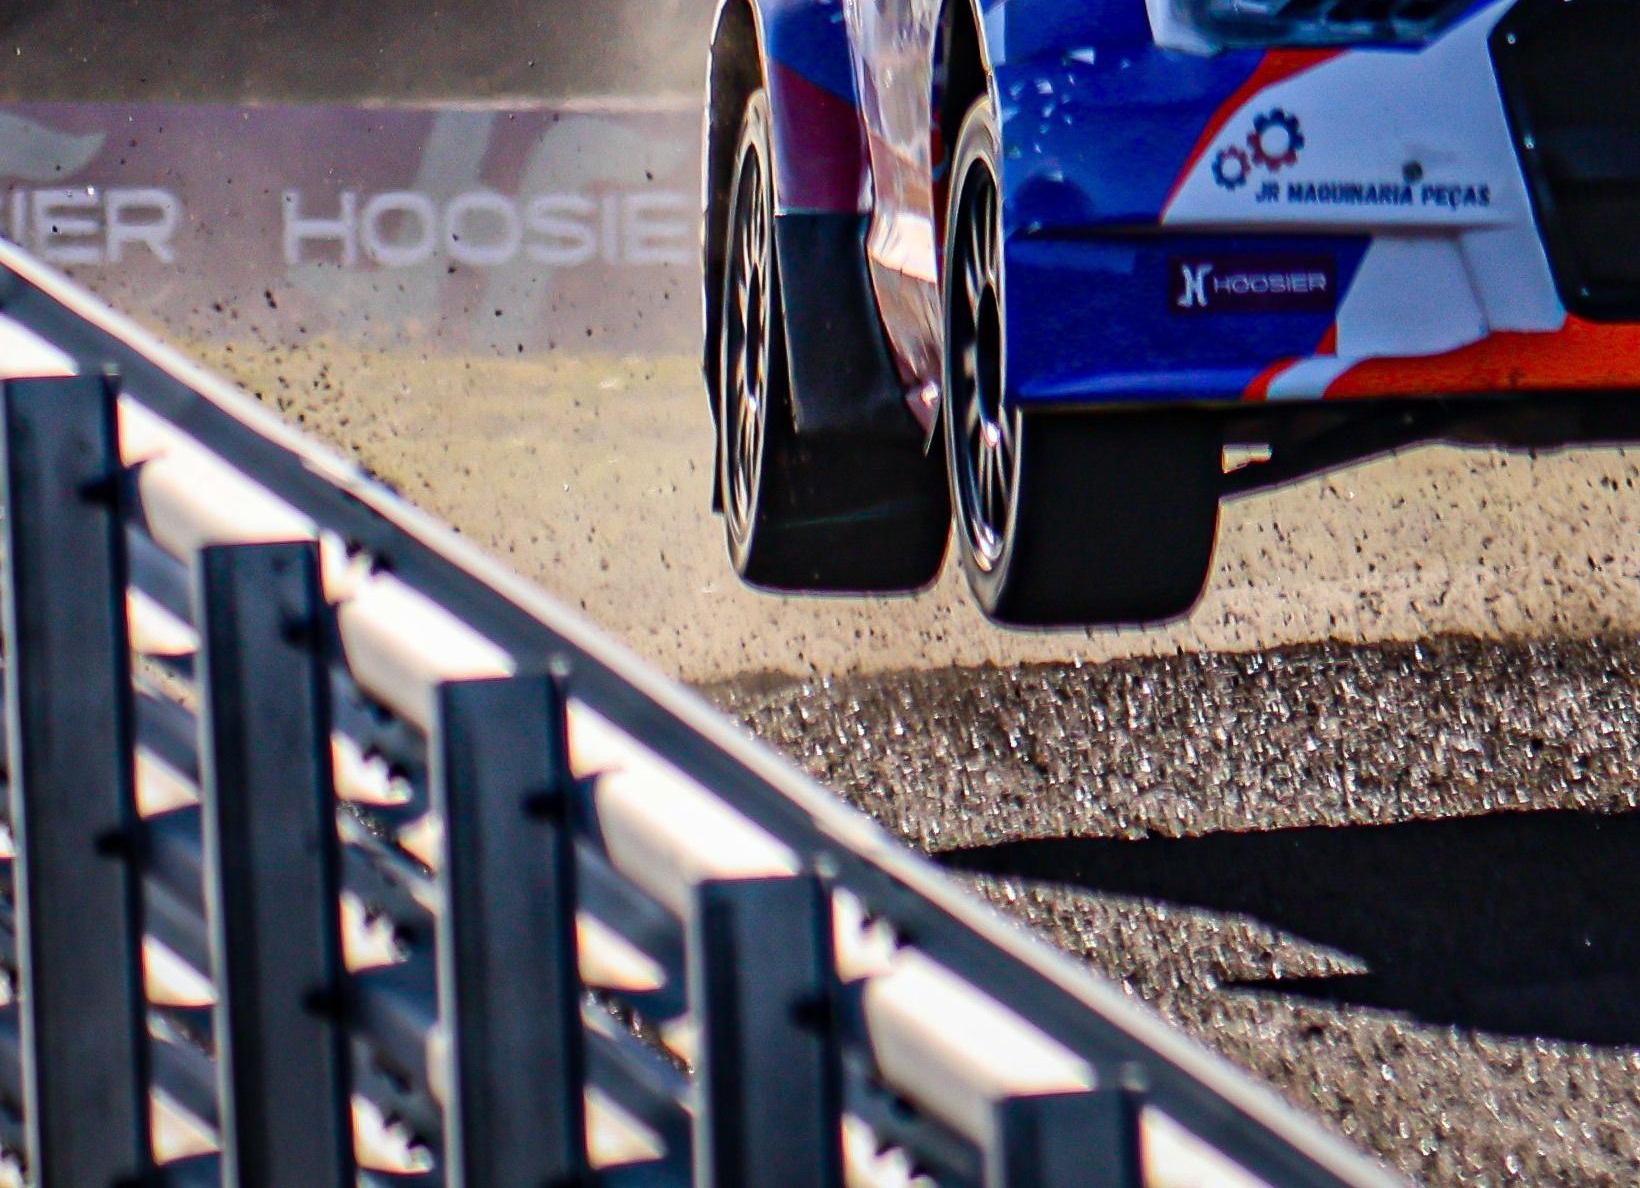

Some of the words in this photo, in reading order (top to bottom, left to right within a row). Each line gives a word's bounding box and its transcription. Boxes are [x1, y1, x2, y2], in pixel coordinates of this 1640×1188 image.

[1256, 182, 1279, 203] JR
[1287, 182, 1414, 205] MAQUINARIA
[1421, 185, 1490, 210] PEÇAS
[0, 188, 180, 263] IER
[282, 190, 696, 267] HOOSIE
[1213, 273, 1327, 294] HOOSIER
